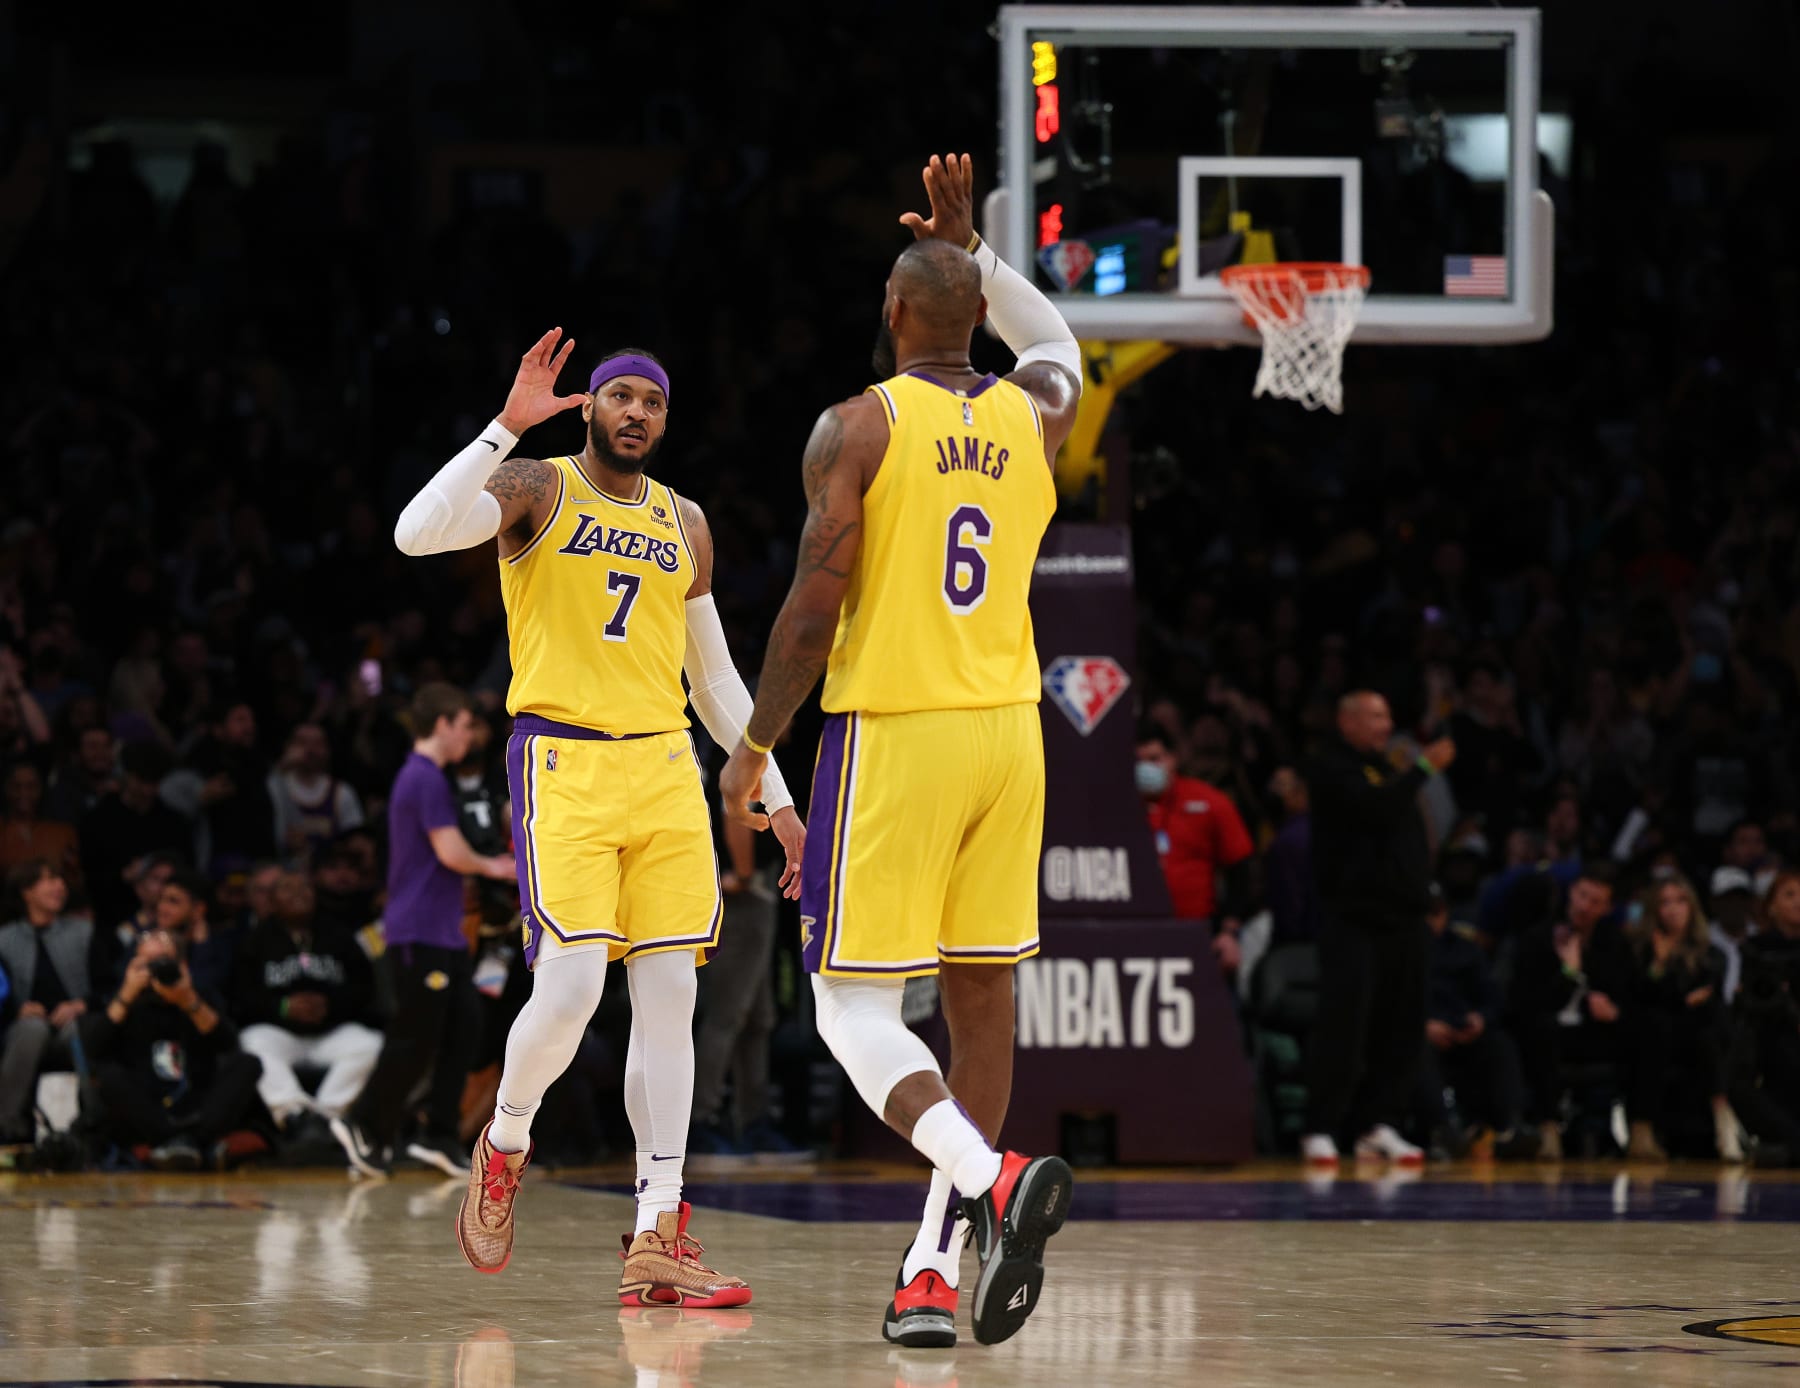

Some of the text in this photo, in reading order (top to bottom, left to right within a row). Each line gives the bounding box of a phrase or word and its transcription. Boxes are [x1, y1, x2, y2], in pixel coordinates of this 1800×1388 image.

[935, 436, 1009, 481] JAMES
[557, 513, 680, 573] LAKERS
[650, 515, 674, 530] bibigo
[942, 503, 992, 616] 6
[602, 569, 642, 643] 7
[1043, 846, 1131, 900] @NBA
[1013, 956, 1196, 1049] NBA75
